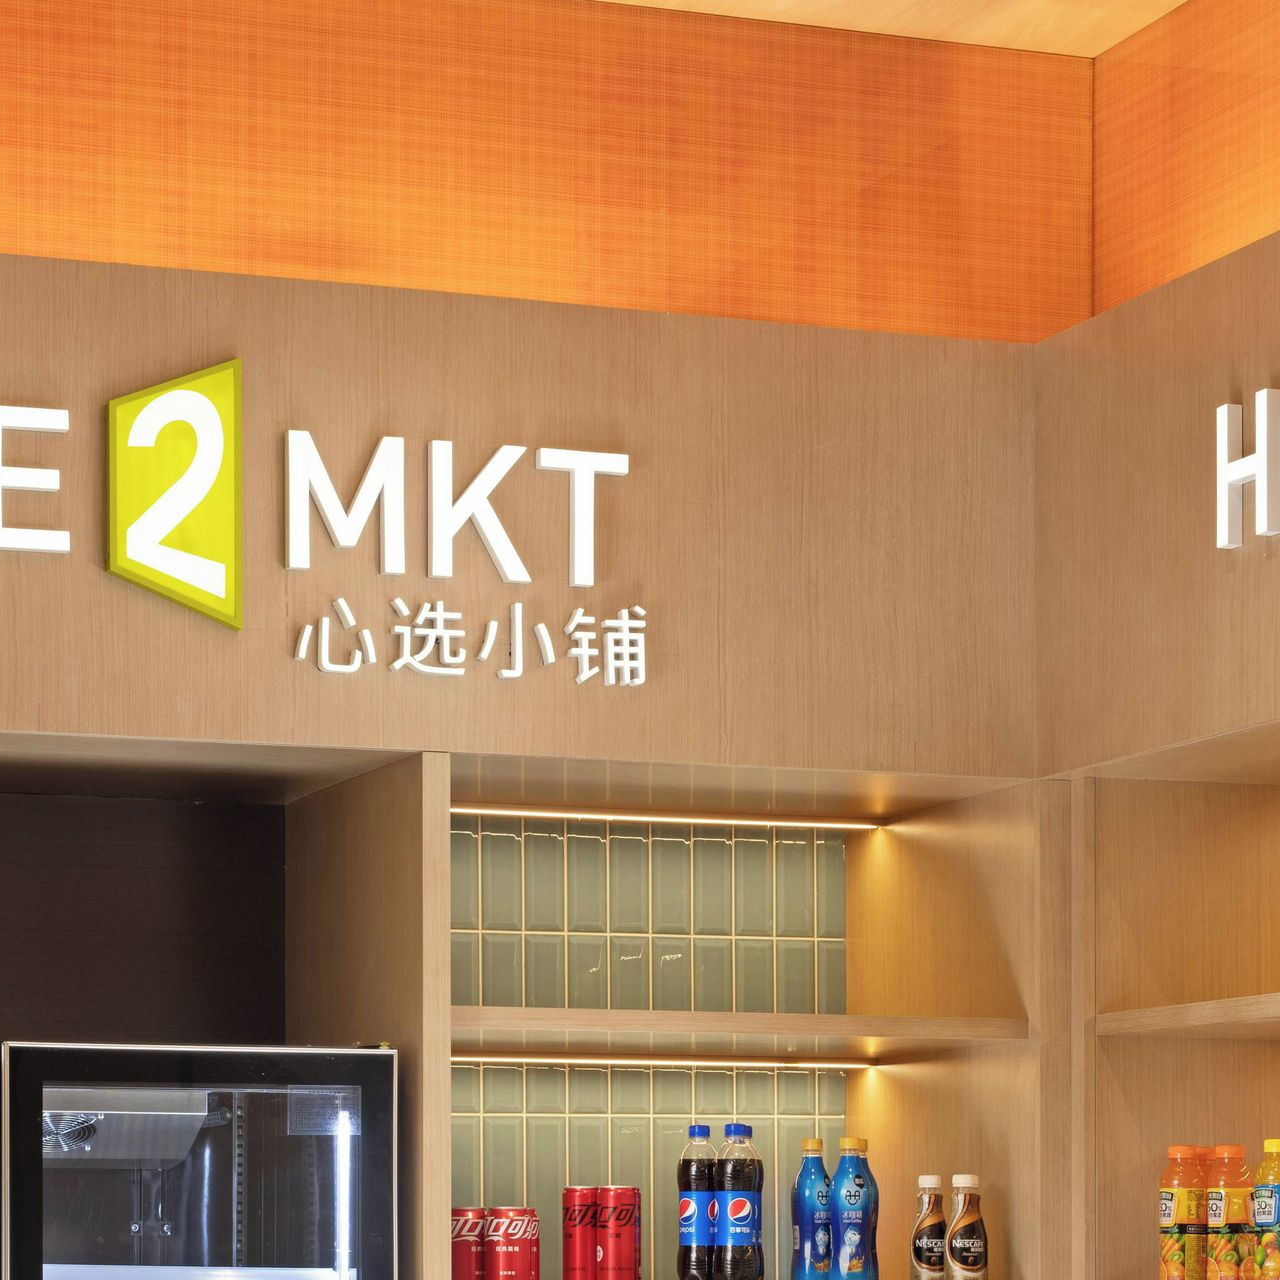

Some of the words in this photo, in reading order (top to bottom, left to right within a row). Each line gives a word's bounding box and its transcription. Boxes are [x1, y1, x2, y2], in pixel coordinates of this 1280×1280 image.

[126, 388, 226, 599] 2
[284, 429, 630, 588] MKT
[295, 596, 648, 687] 心选小铺
